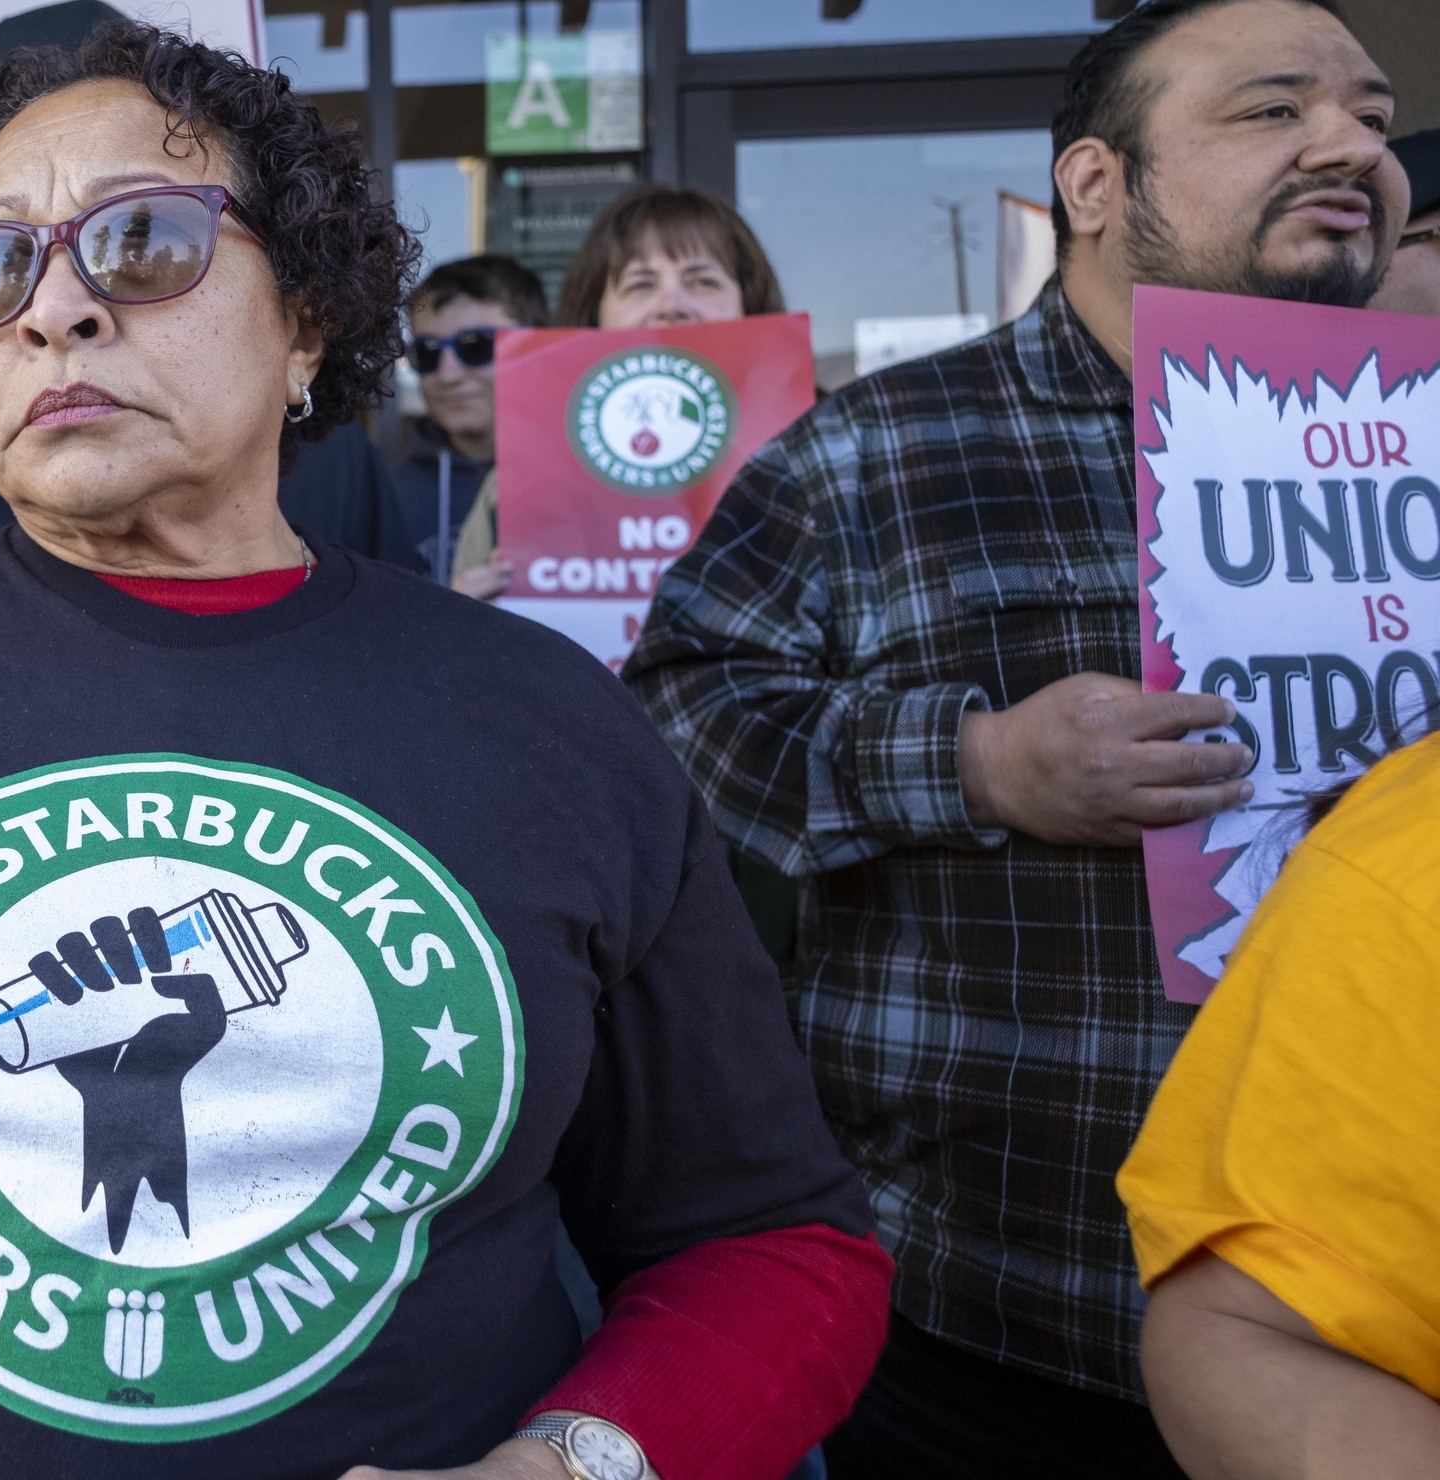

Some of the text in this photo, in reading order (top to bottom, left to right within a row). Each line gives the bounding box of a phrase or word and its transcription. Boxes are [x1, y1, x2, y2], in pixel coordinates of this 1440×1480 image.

[508, 61, 572, 129] A
[587, 354, 717, 398] STARBUCKS
[579, 402, 728, 488] WORKERS UNITED
[1303, 420, 1412, 469] OUR
[618, 514, 691, 551] NO
[527, 555, 677, 593] CONT
[1362, 593, 1409, 642] IS
[1200, 649, 1440, 777] STRO
[194, 1103, 462, 1362] UNITED
